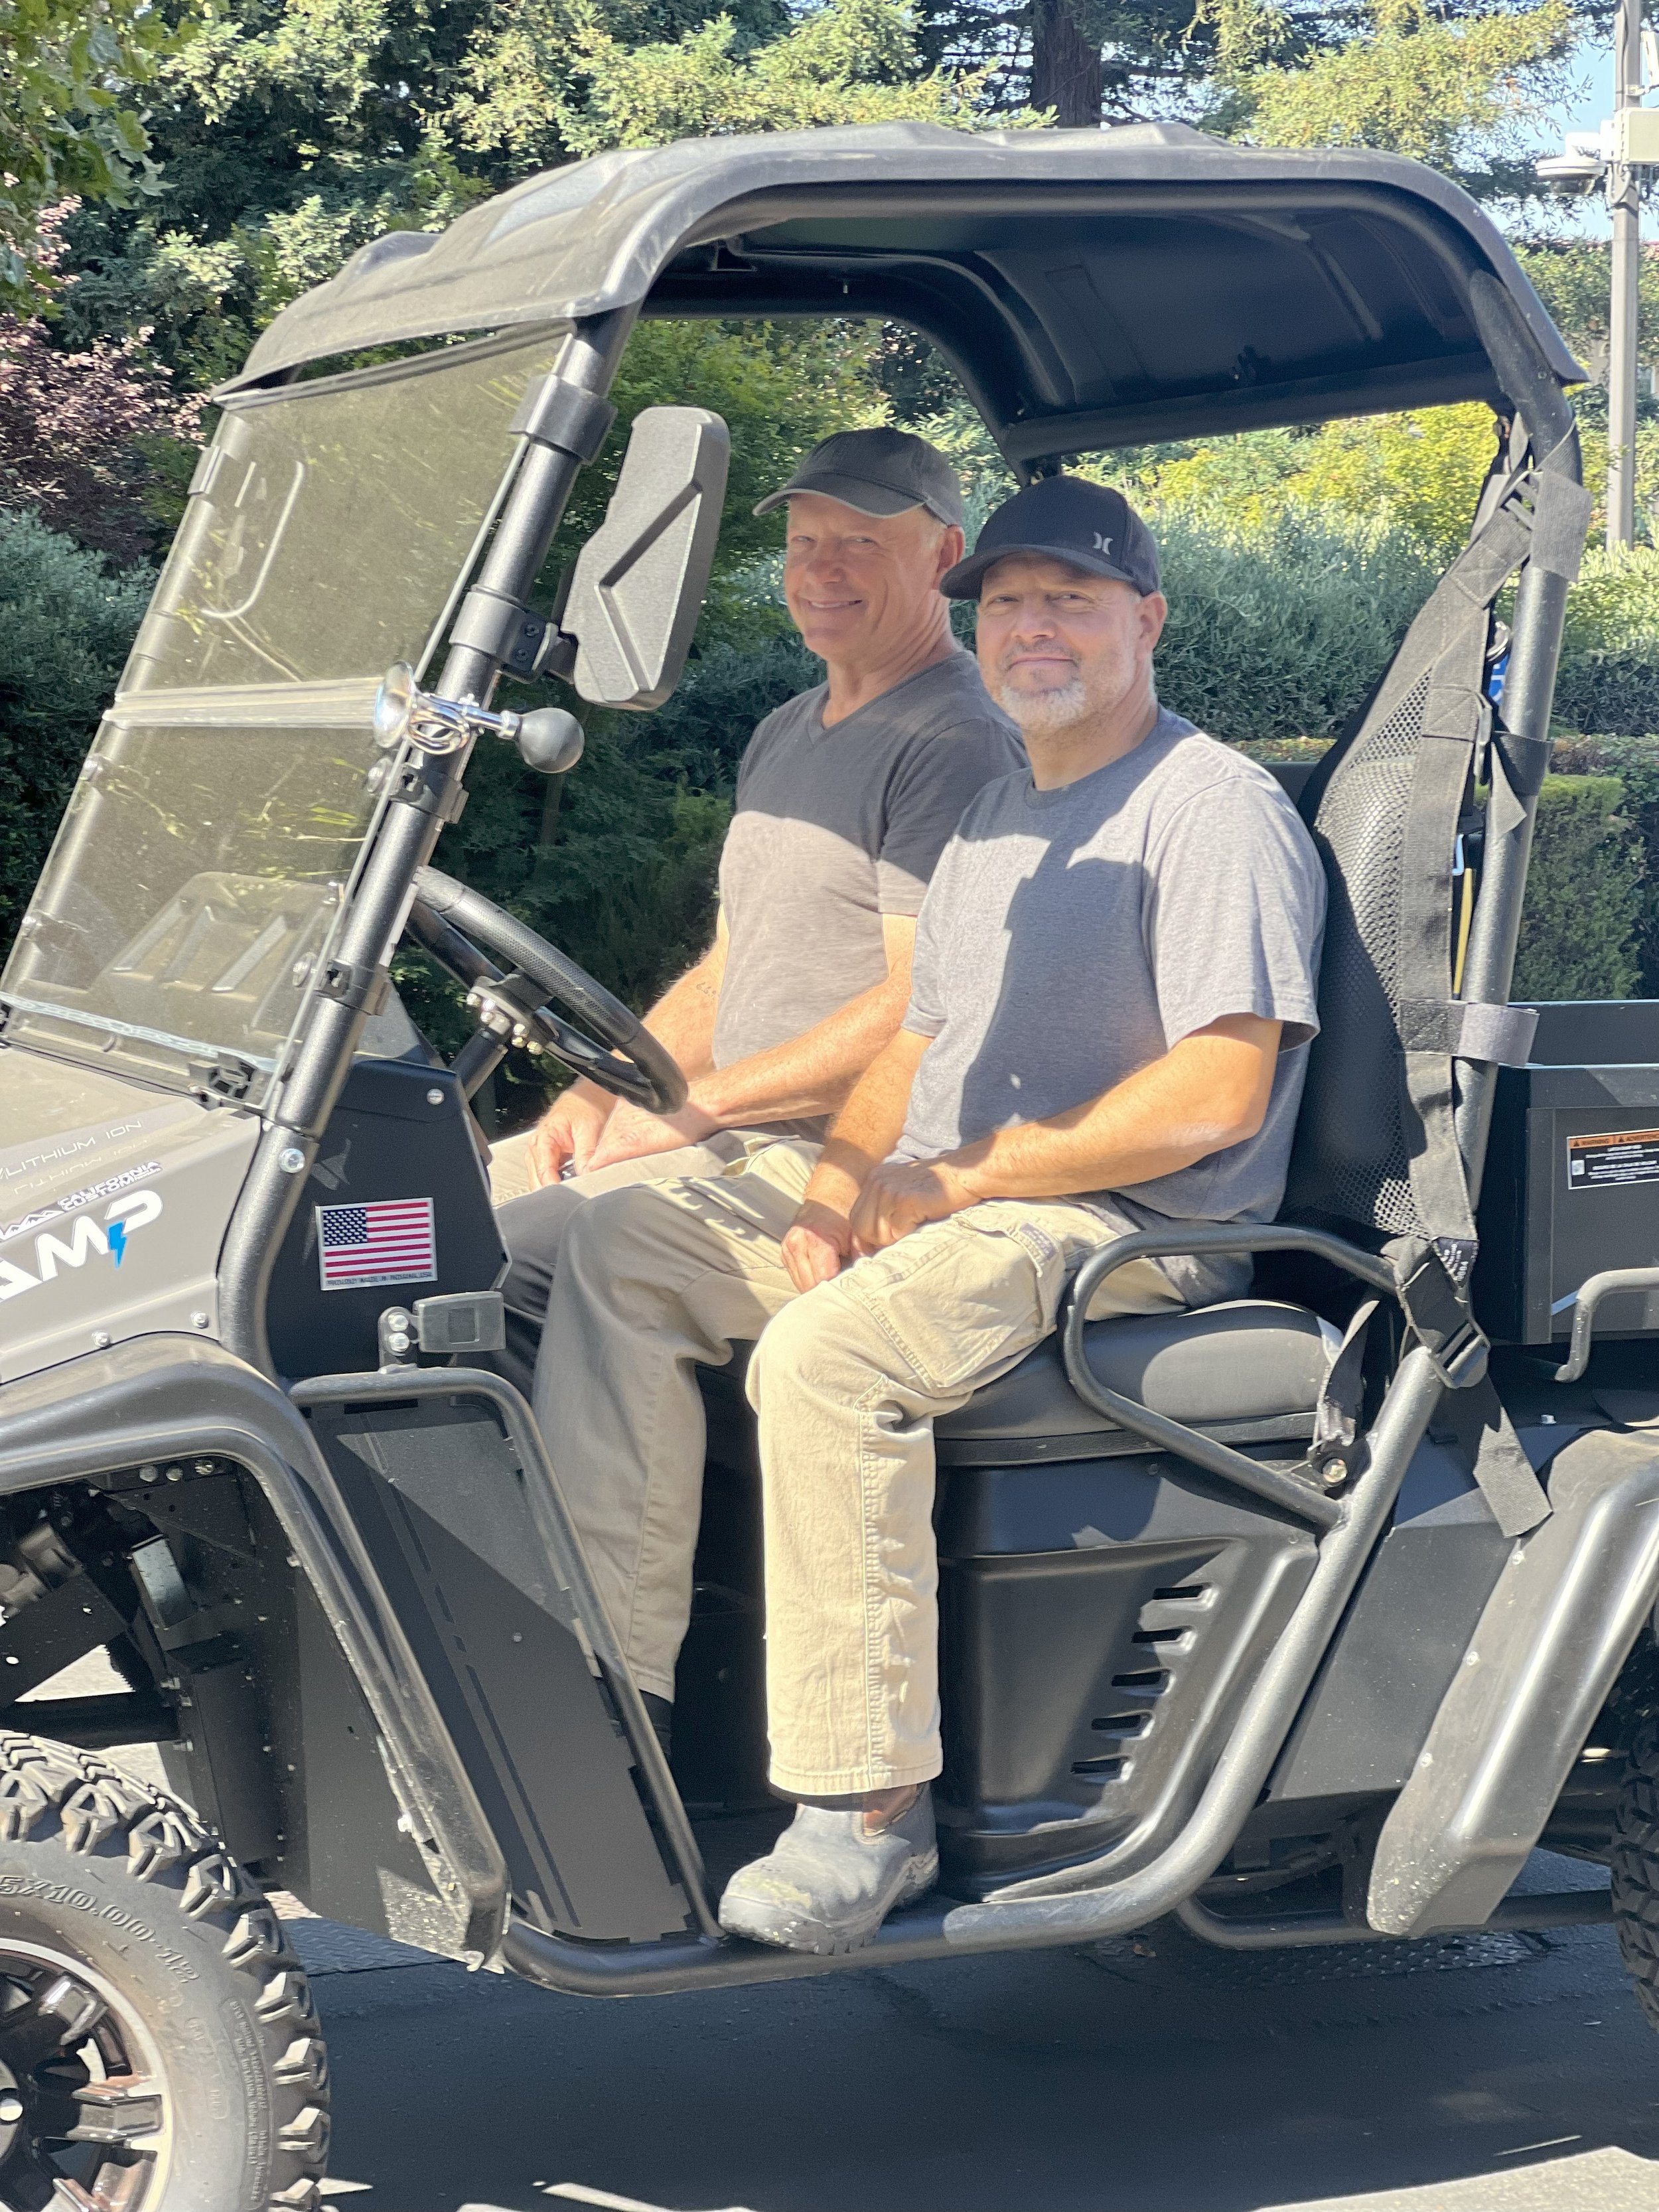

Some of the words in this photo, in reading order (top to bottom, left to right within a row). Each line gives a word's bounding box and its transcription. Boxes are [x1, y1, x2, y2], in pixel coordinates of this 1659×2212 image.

[5, 1136, 96, 1177] LITHIUM
[106, 1120, 142, 1139] ION
[58, 1161, 160, 1206] CALIFORNIA
